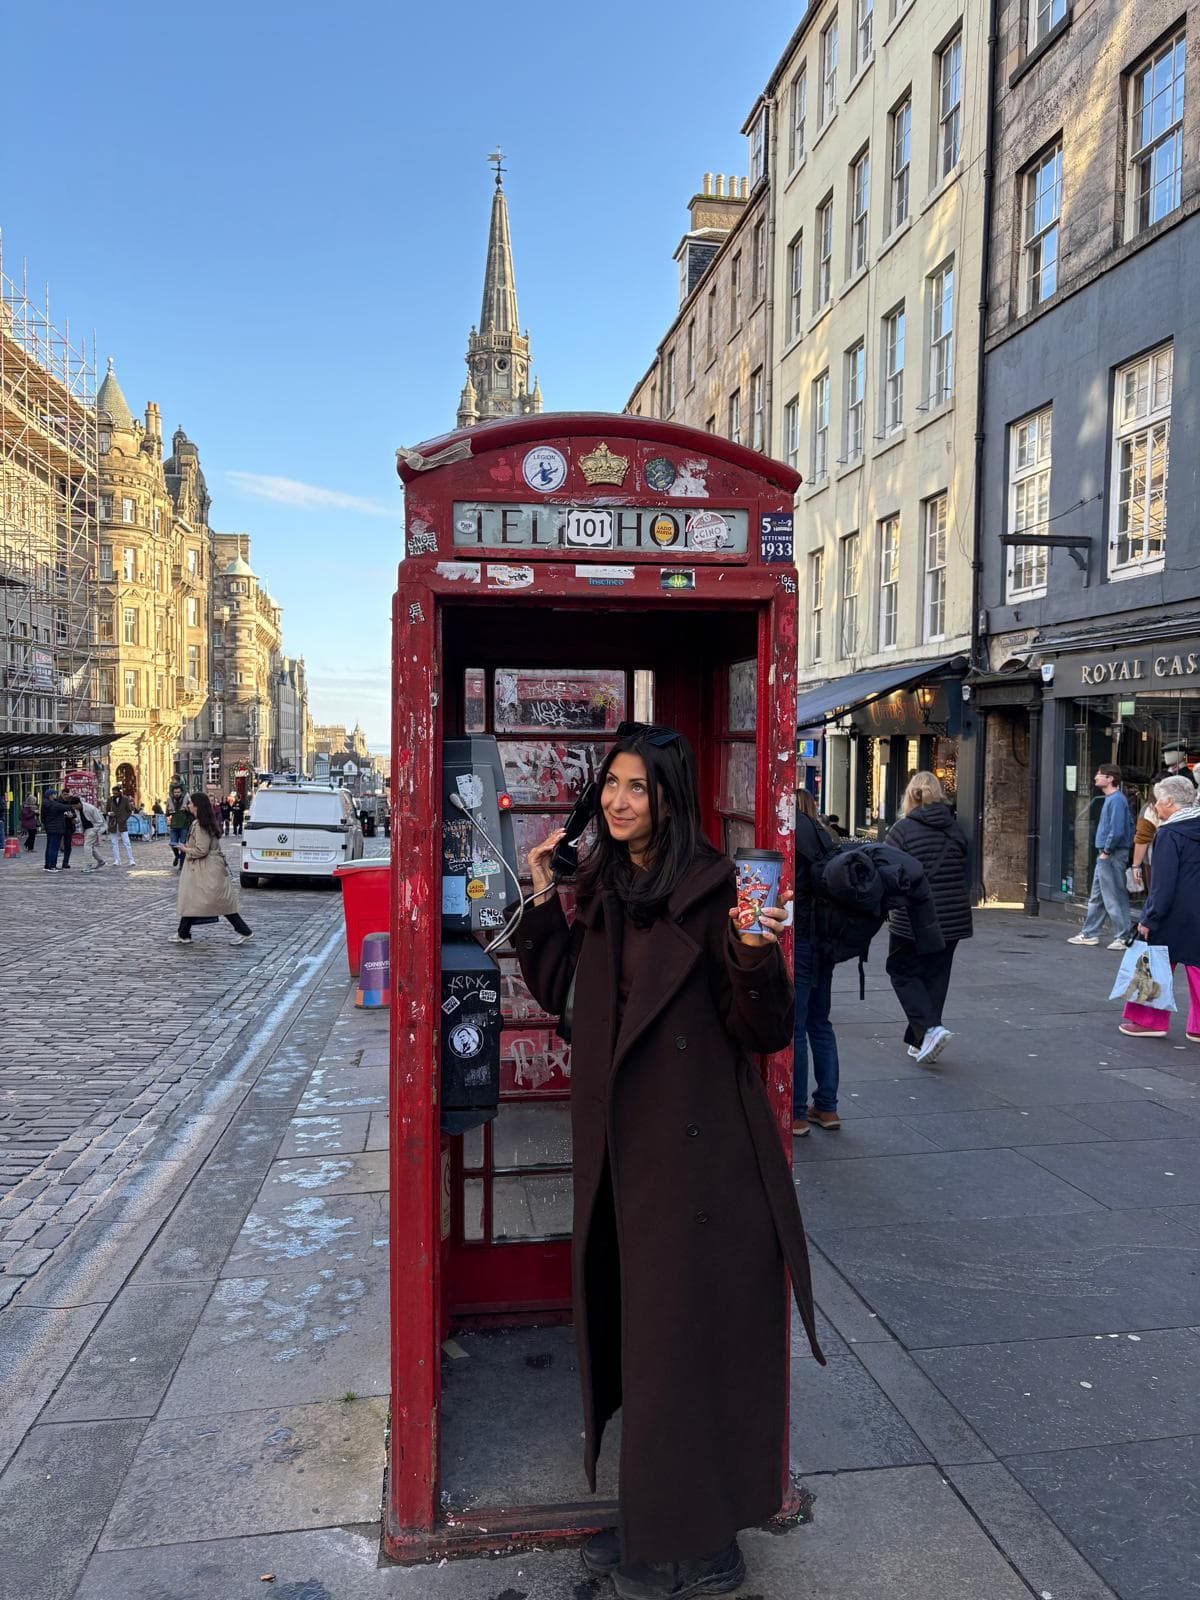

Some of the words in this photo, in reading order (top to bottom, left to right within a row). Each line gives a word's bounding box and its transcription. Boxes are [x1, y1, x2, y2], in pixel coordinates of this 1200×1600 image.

[575, 518, 605, 538] 101
[761, 517, 772, 534] 5
[761, 542, 793, 556] 1933
[1081, 659, 1143, 684] ROYAL
[1154, 653, 1200, 677] CAS
